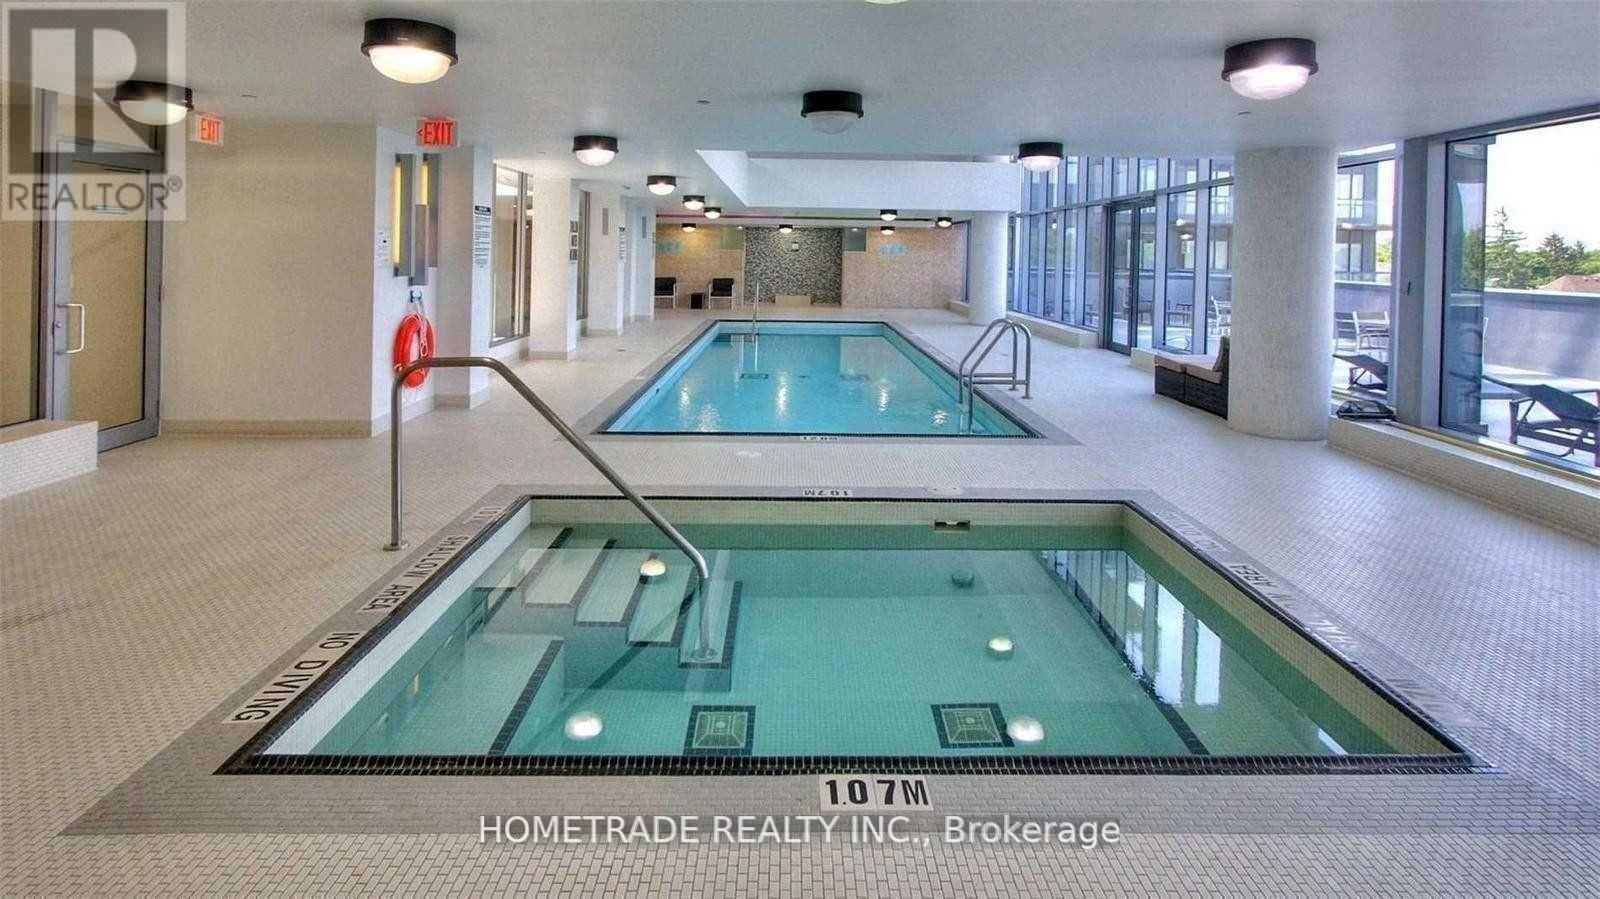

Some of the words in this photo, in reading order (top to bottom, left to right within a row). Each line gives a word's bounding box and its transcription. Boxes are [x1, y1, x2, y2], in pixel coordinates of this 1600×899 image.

[201, 118, 220, 142] EXIT
[423, 121, 454, 145] EXIT
[363, 584, 413, 611] AREA
[319, 632, 360, 649] NO
[231, 660, 329, 721] DIVING
